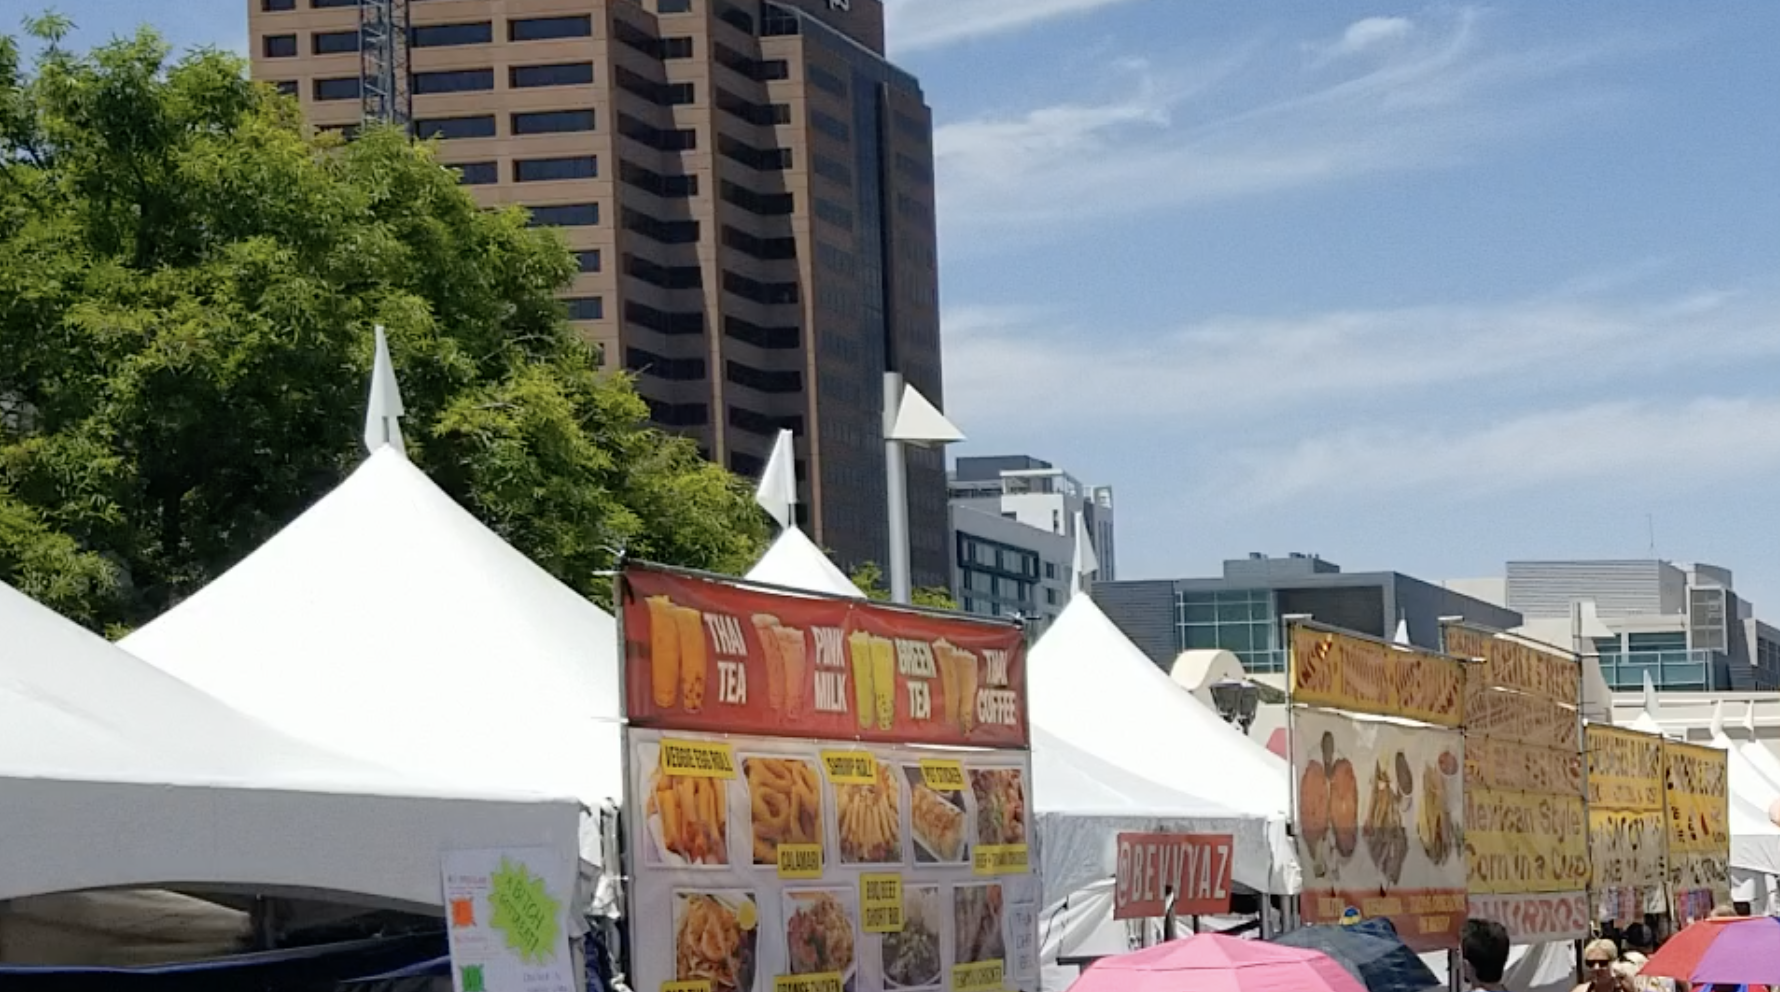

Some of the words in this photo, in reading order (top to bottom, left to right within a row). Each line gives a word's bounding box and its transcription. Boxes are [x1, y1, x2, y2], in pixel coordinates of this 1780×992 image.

[703, 613, 748, 657] THAI
[810, 625, 846, 668] PINK
[717, 661, 748, 705] TEA
[982, 649, 1008, 685] THAI
[814, 671, 848, 713] MILK
[907, 680, 931, 720] TEA
[977, 688, 1017, 726] COFFEE
[709, 750, 733, 771] ROLL
[1464, 792, 1535, 834] Mexican
[1538, 799, 1582, 844] Style
[781, 850, 820, 871] CALAMARI
[1551, 848, 1587, 888] Cup
